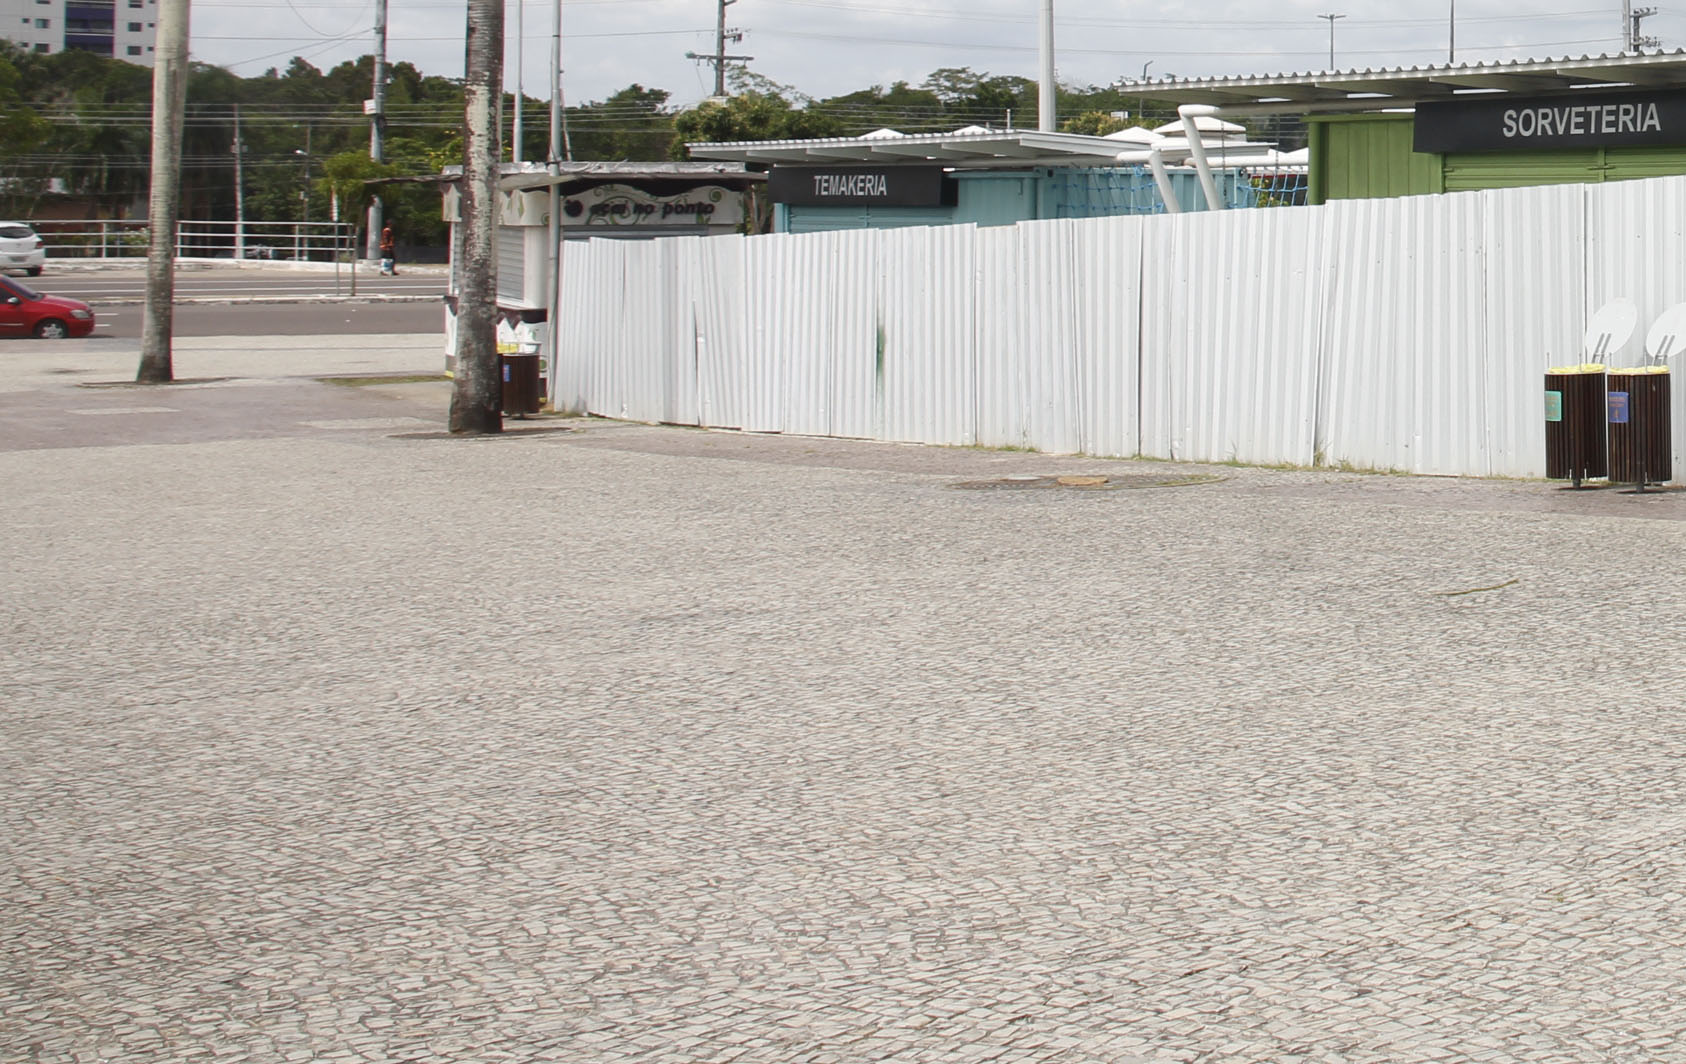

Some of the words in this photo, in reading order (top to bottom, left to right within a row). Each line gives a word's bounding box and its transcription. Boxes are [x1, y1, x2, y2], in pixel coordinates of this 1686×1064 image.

[1502, 102, 1662, 137] SORVETERIA
[814, 175, 887, 196] TEMAKERIA
[661, 201, 715, 219] ponto
